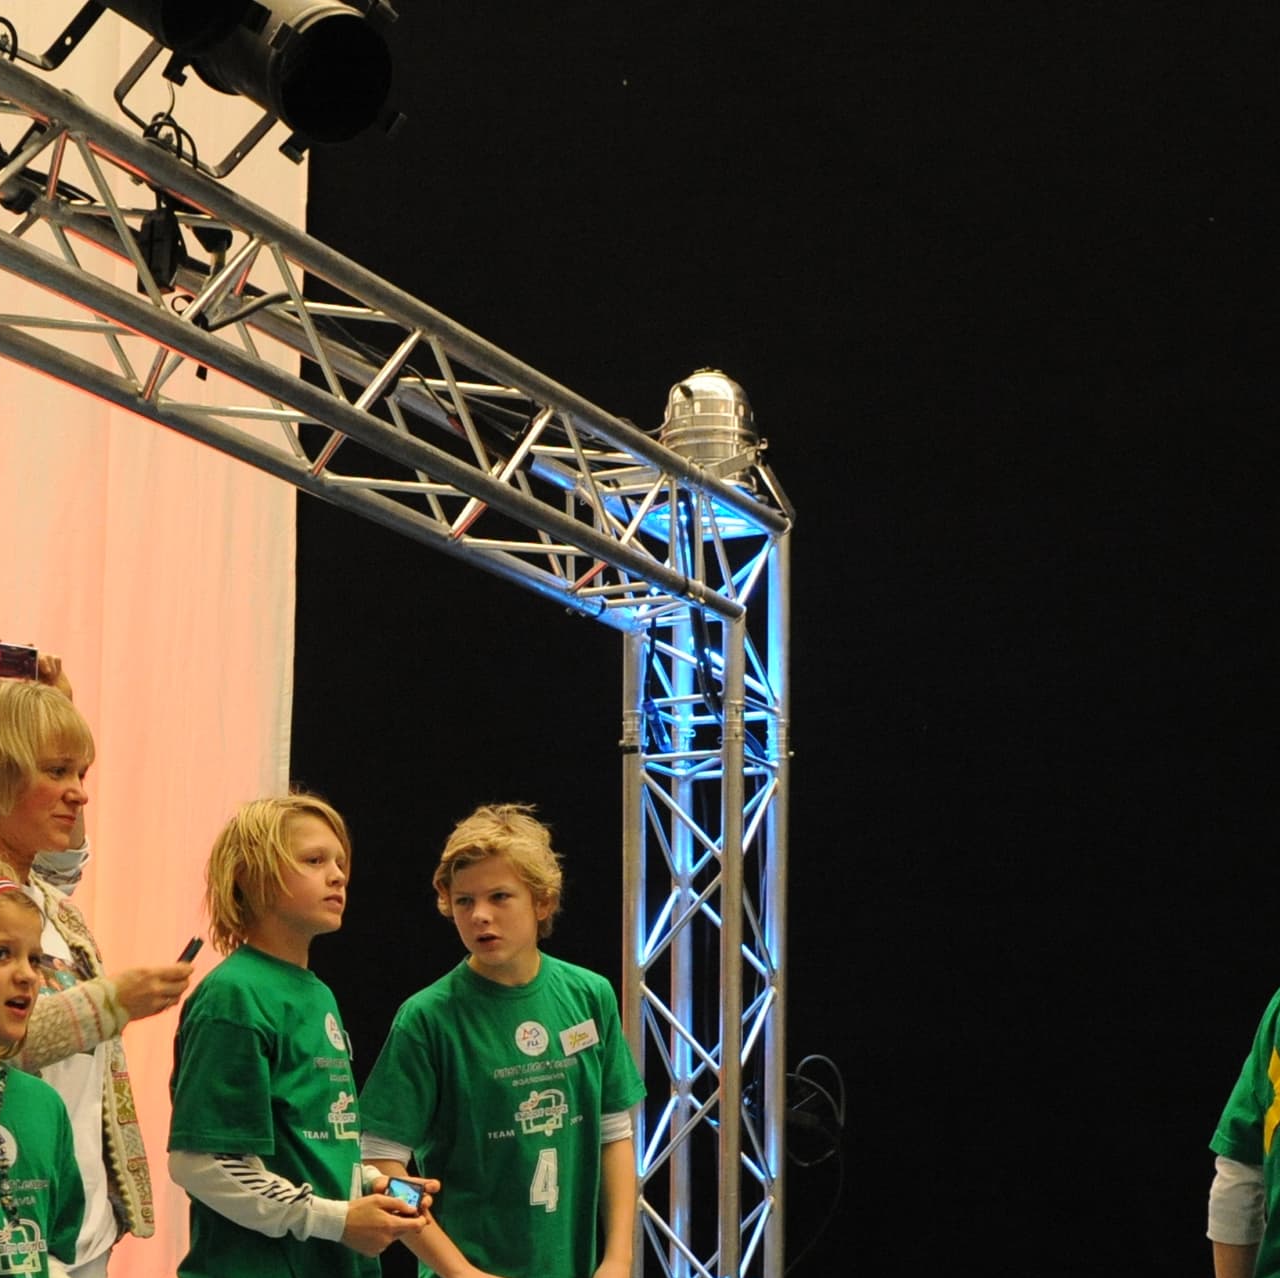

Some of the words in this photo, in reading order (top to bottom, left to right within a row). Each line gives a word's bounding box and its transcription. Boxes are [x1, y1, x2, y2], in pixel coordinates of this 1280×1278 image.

[303, 1130, 329, 1140] TEAM
[487, 1129, 516, 1140] TEAM
[529, 1148, 560, 1213] 4
